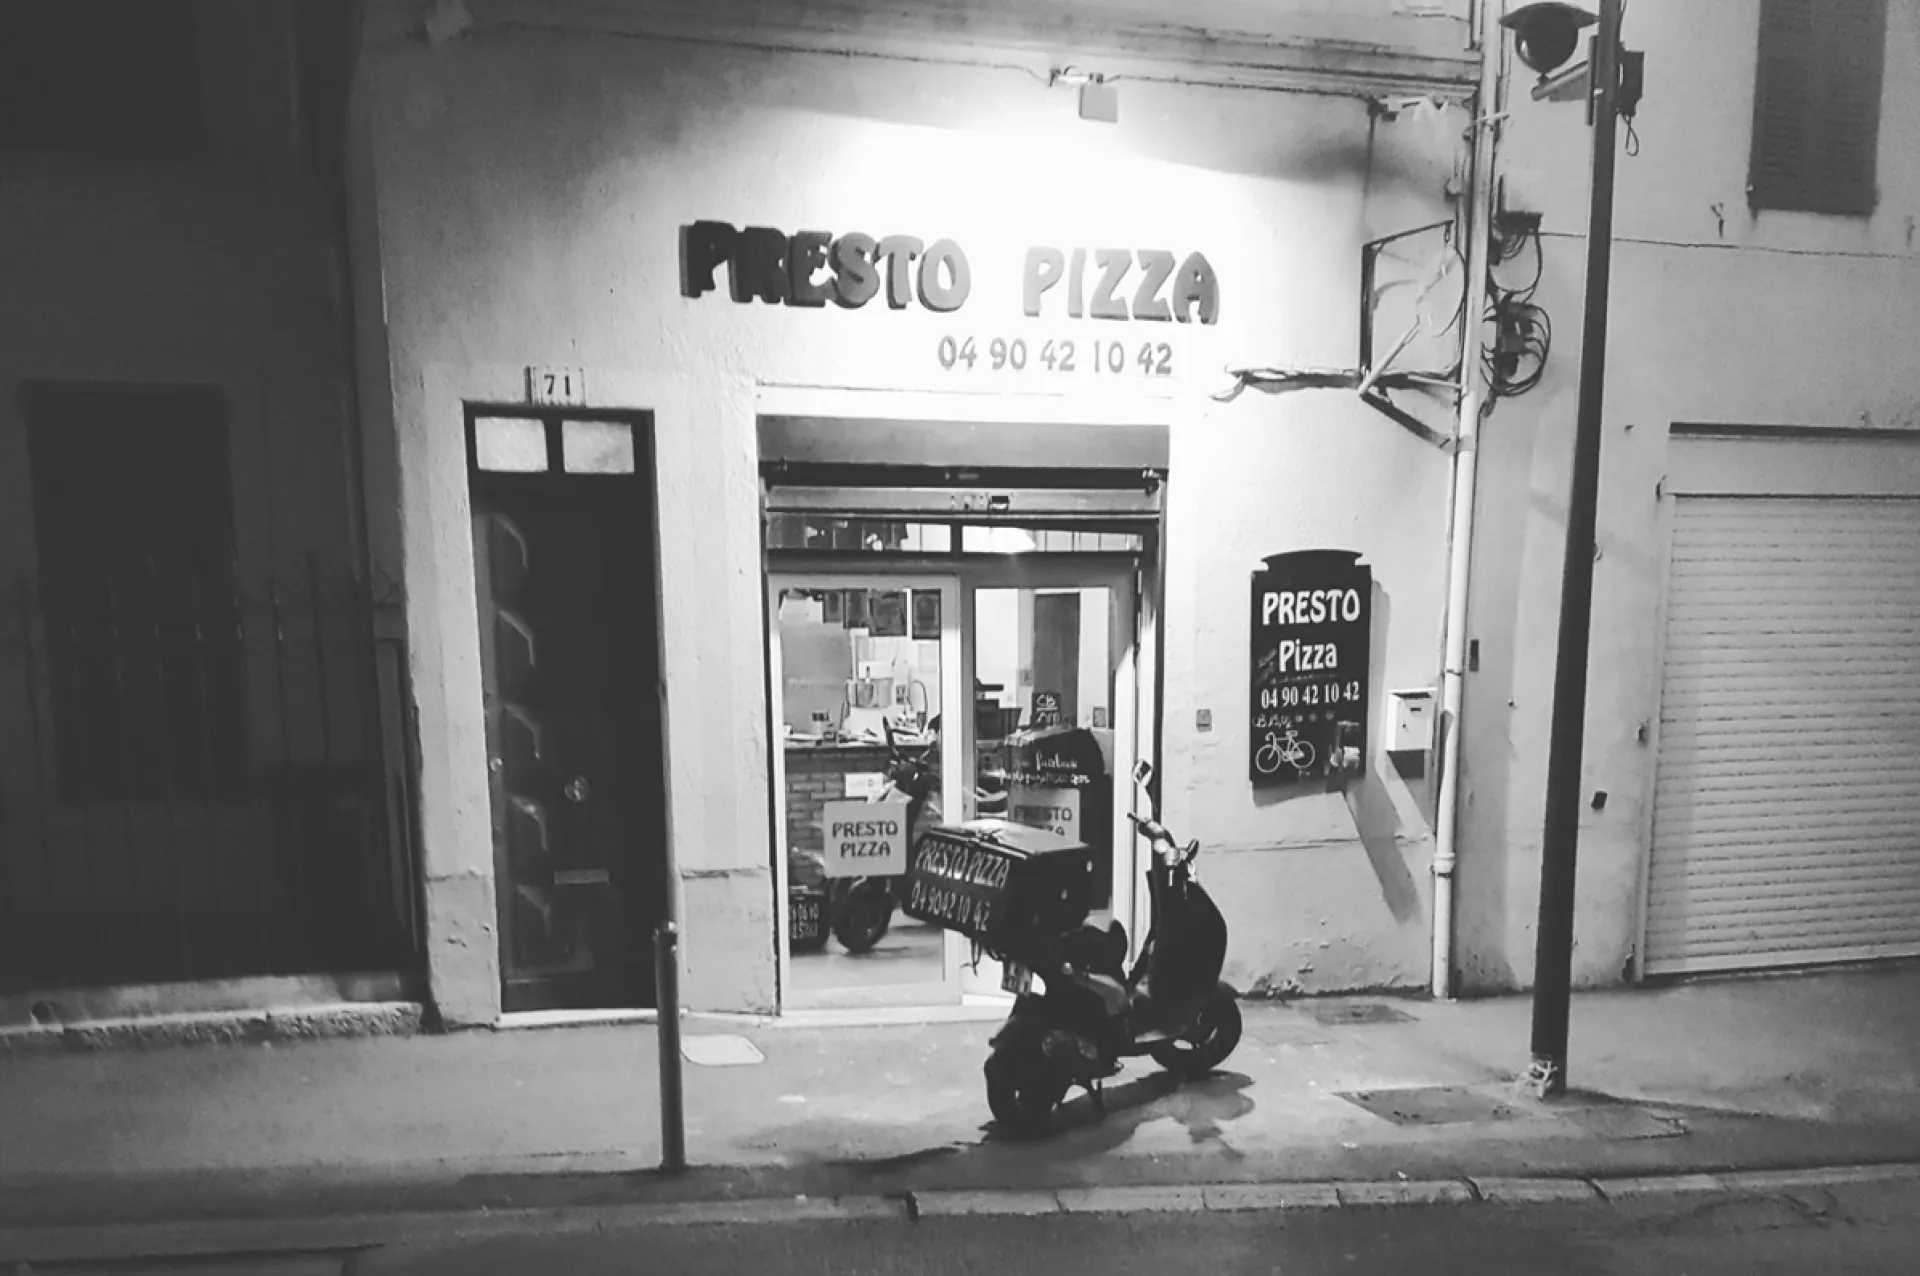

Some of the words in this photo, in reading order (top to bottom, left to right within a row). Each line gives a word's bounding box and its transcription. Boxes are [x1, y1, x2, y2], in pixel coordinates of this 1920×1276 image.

[679, 220, 972, 312] PRESTO
[1022, 245, 1220, 325] PIZZA
[937, 336, 978, 369] 04
[989, 338, 1027, 371] 90
[1039, 339, 1076, 373] 42
[1093, 340, 1125, 374] 10
[1137, 342, 1173, 375] 42
[543, 373, 571, 396] 71
[1262, 588, 1361, 626] PRESTO
[1279, 638, 1338, 673] Pizza
[1261, 687, 1278, 709] 04
[1281, 685, 1299, 707] 90
[1302, 683, 1319, 705] 42
[1324, 682, 1340, 703] 10
[1343, 680, 1360, 701] 42
[832, 820, 899, 838] PRESTO
[840, 840, 892, 858] PIZZA
[914, 839, 970, 880] PRESTO
[964, 851, 1011, 889] PIZZA
